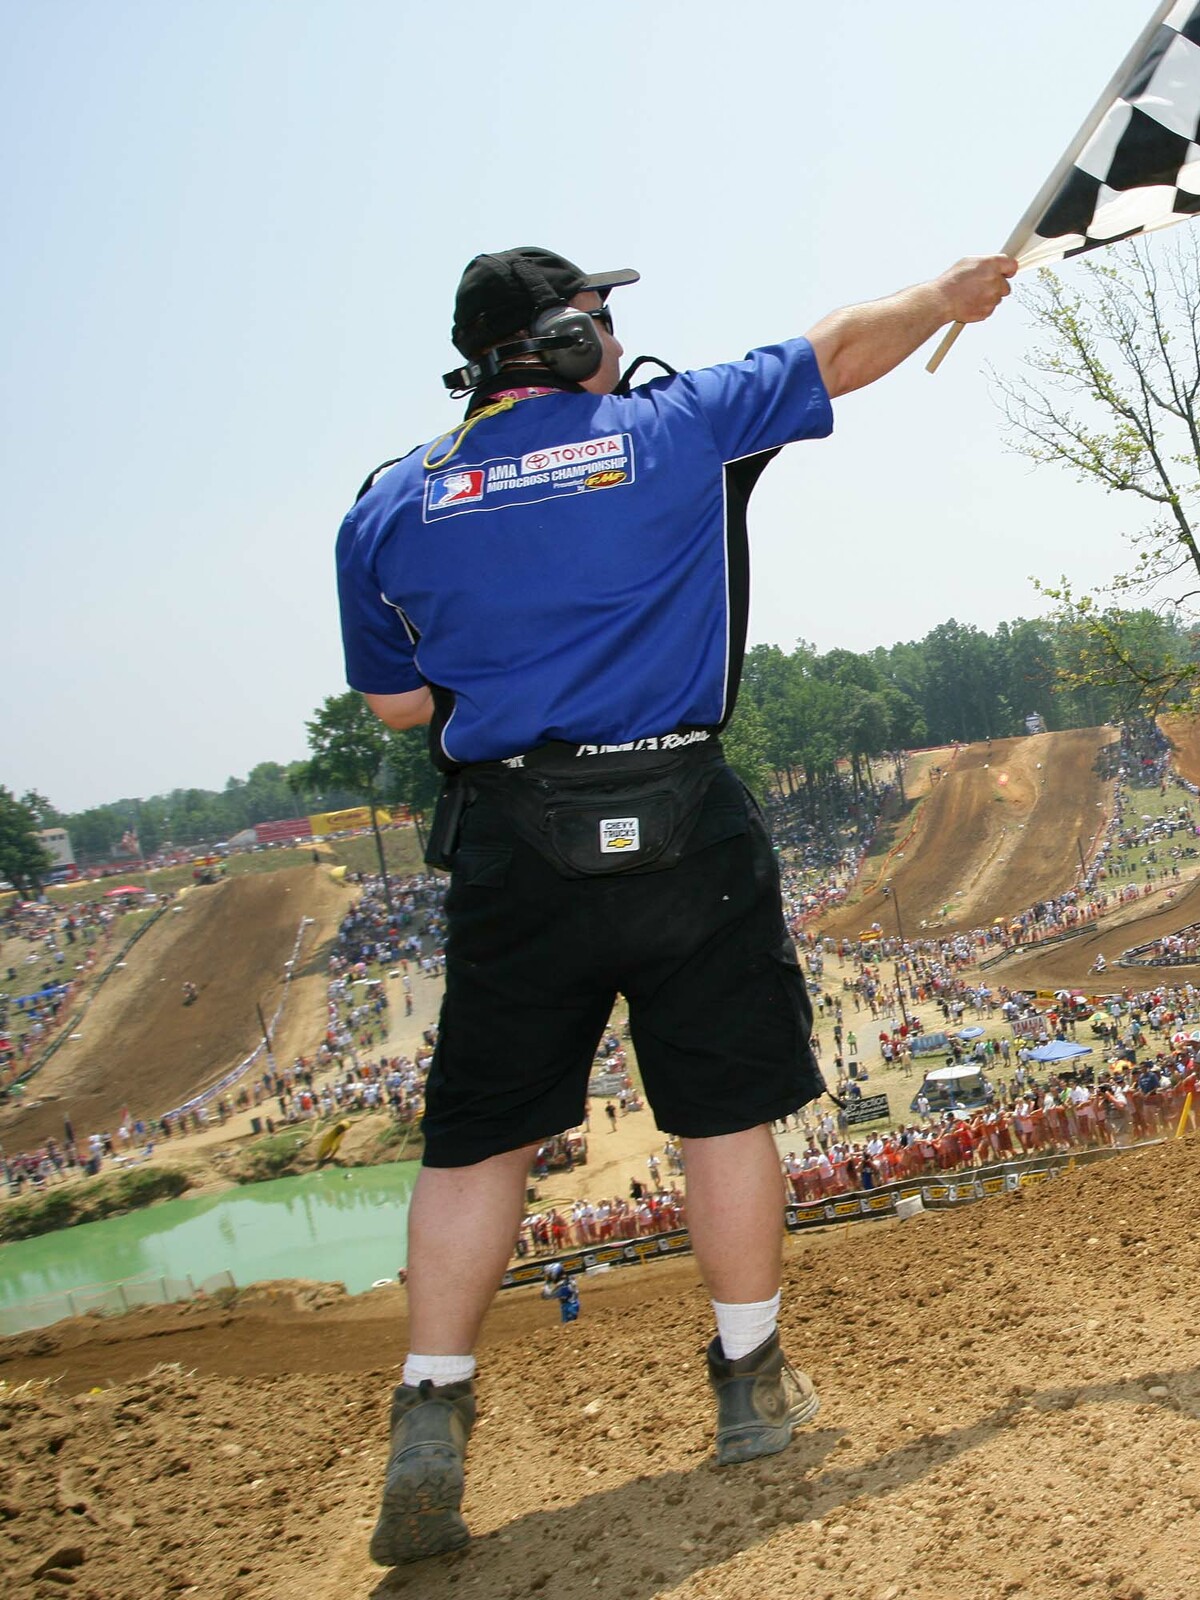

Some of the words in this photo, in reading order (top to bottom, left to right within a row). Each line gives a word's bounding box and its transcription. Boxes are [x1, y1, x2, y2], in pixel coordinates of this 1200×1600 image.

[551, 440, 620, 462] TOYOTA
[486, 472, 550, 494] MOTOCROSS
[551, 456, 628, 481] CHAMPIONSHIP
[488, 463, 518, 481] AMA
[603, 829, 637, 838] TRUCKS
[605, 821, 635, 830] CHEVY
